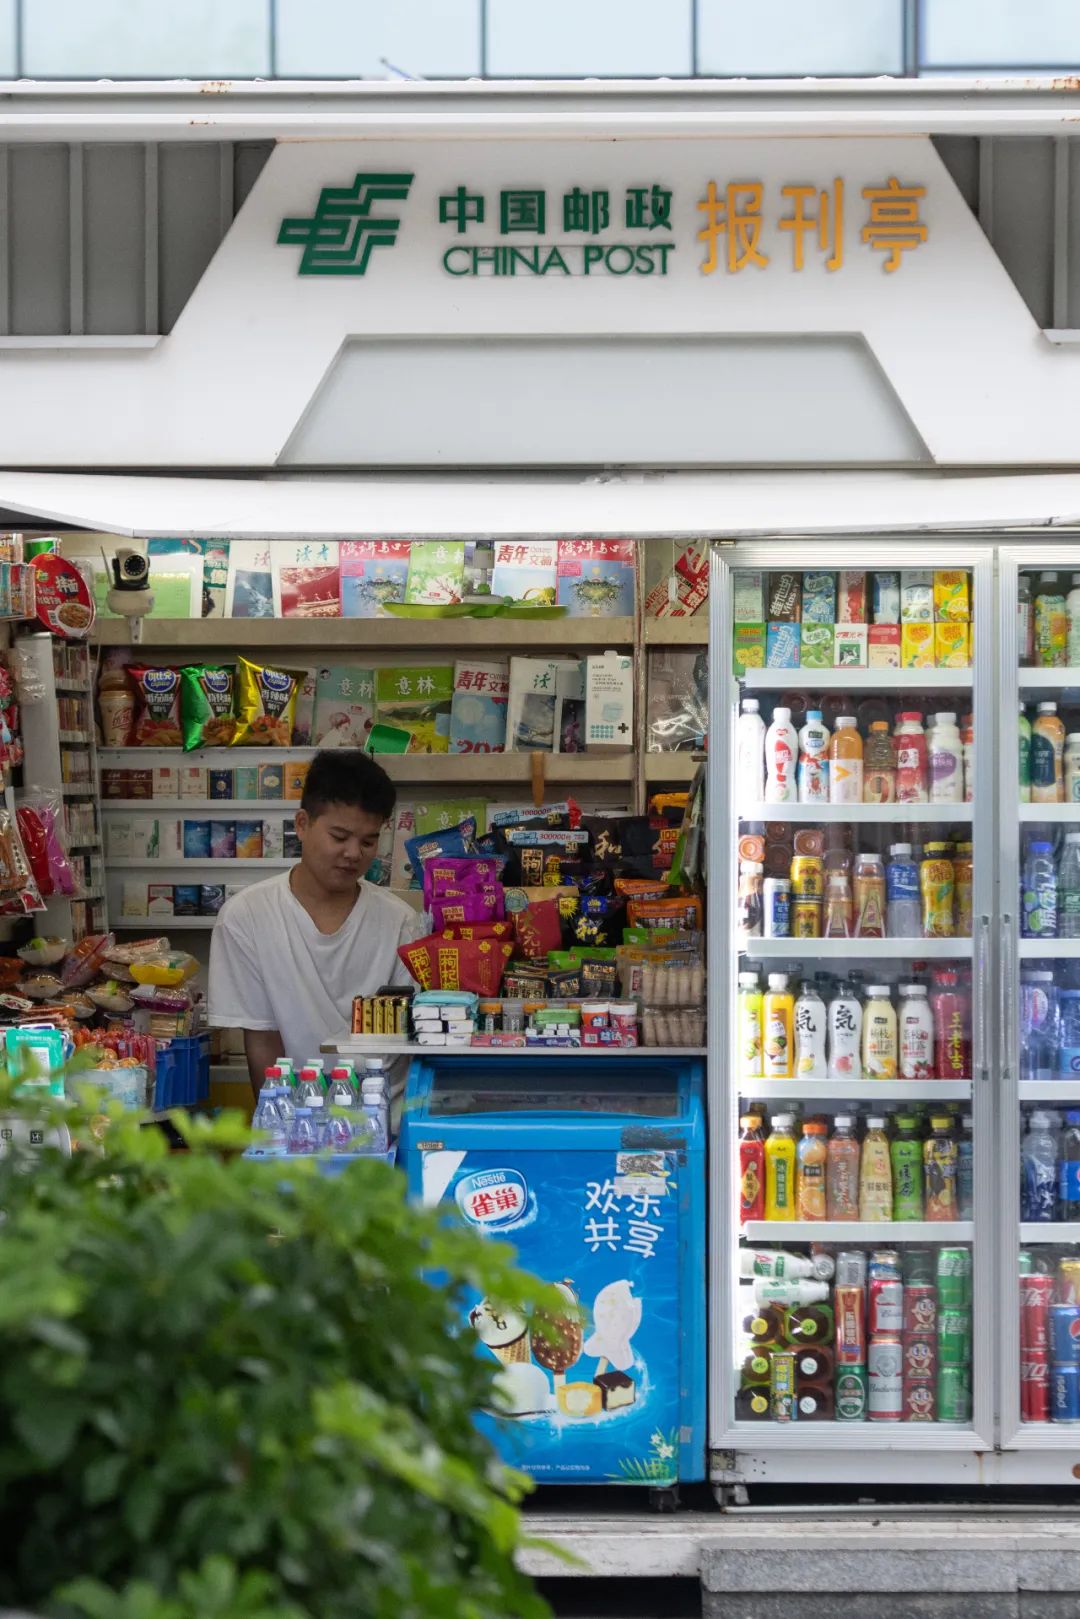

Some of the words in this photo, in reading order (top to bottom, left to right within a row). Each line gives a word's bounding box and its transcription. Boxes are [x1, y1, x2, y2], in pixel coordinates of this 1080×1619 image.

[438, 184, 673, 234] 中国邮政
[698, 177, 928, 274] 报刊亭
[443, 244, 569, 276] CHINA
[583, 244, 676, 275] POST
[497, 544, 530, 564] 青年
[395, 675, 437, 696] 意林
[457, 670, 490, 692] 青年
[471, 1186, 519, 1217] 雀巢
[586, 1179, 661, 1218] 欢乐
[584, 1216, 665, 1259] 共享
[1056, 1375, 1068, 1409] pepsi
